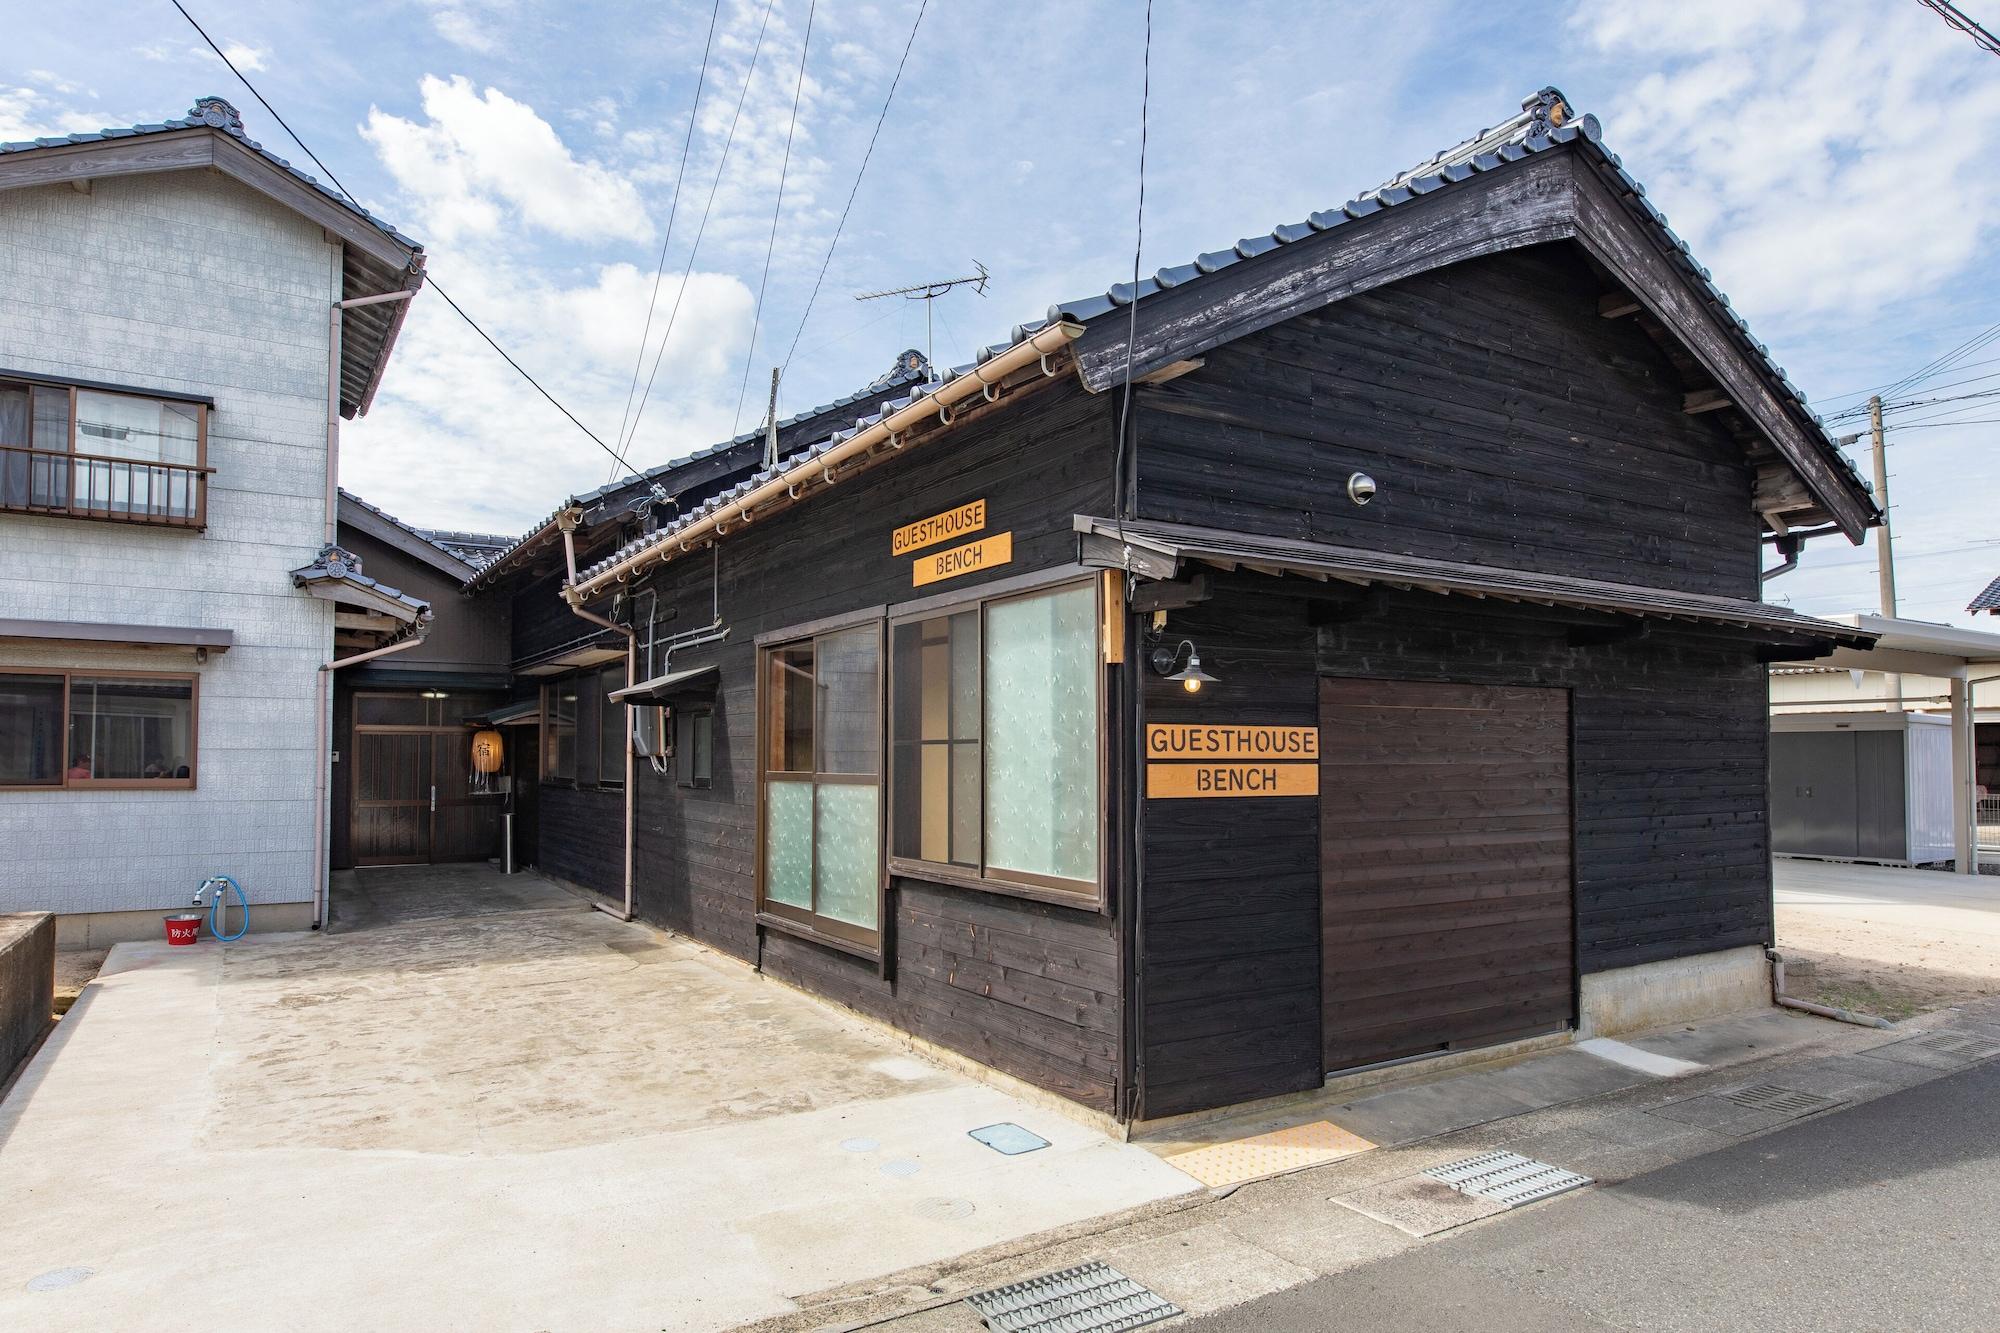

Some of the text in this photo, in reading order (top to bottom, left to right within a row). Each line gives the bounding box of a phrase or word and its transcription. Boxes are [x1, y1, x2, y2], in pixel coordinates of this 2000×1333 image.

[894, 504, 983, 551] GUESTHOUSE
[936, 544, 982, 575] BENCH
[477, 742, 490, 757] 宿
[1150, 728, 1315, 753] GUESTHOUSE
[1197, 768, 1276, 791] BENCH
